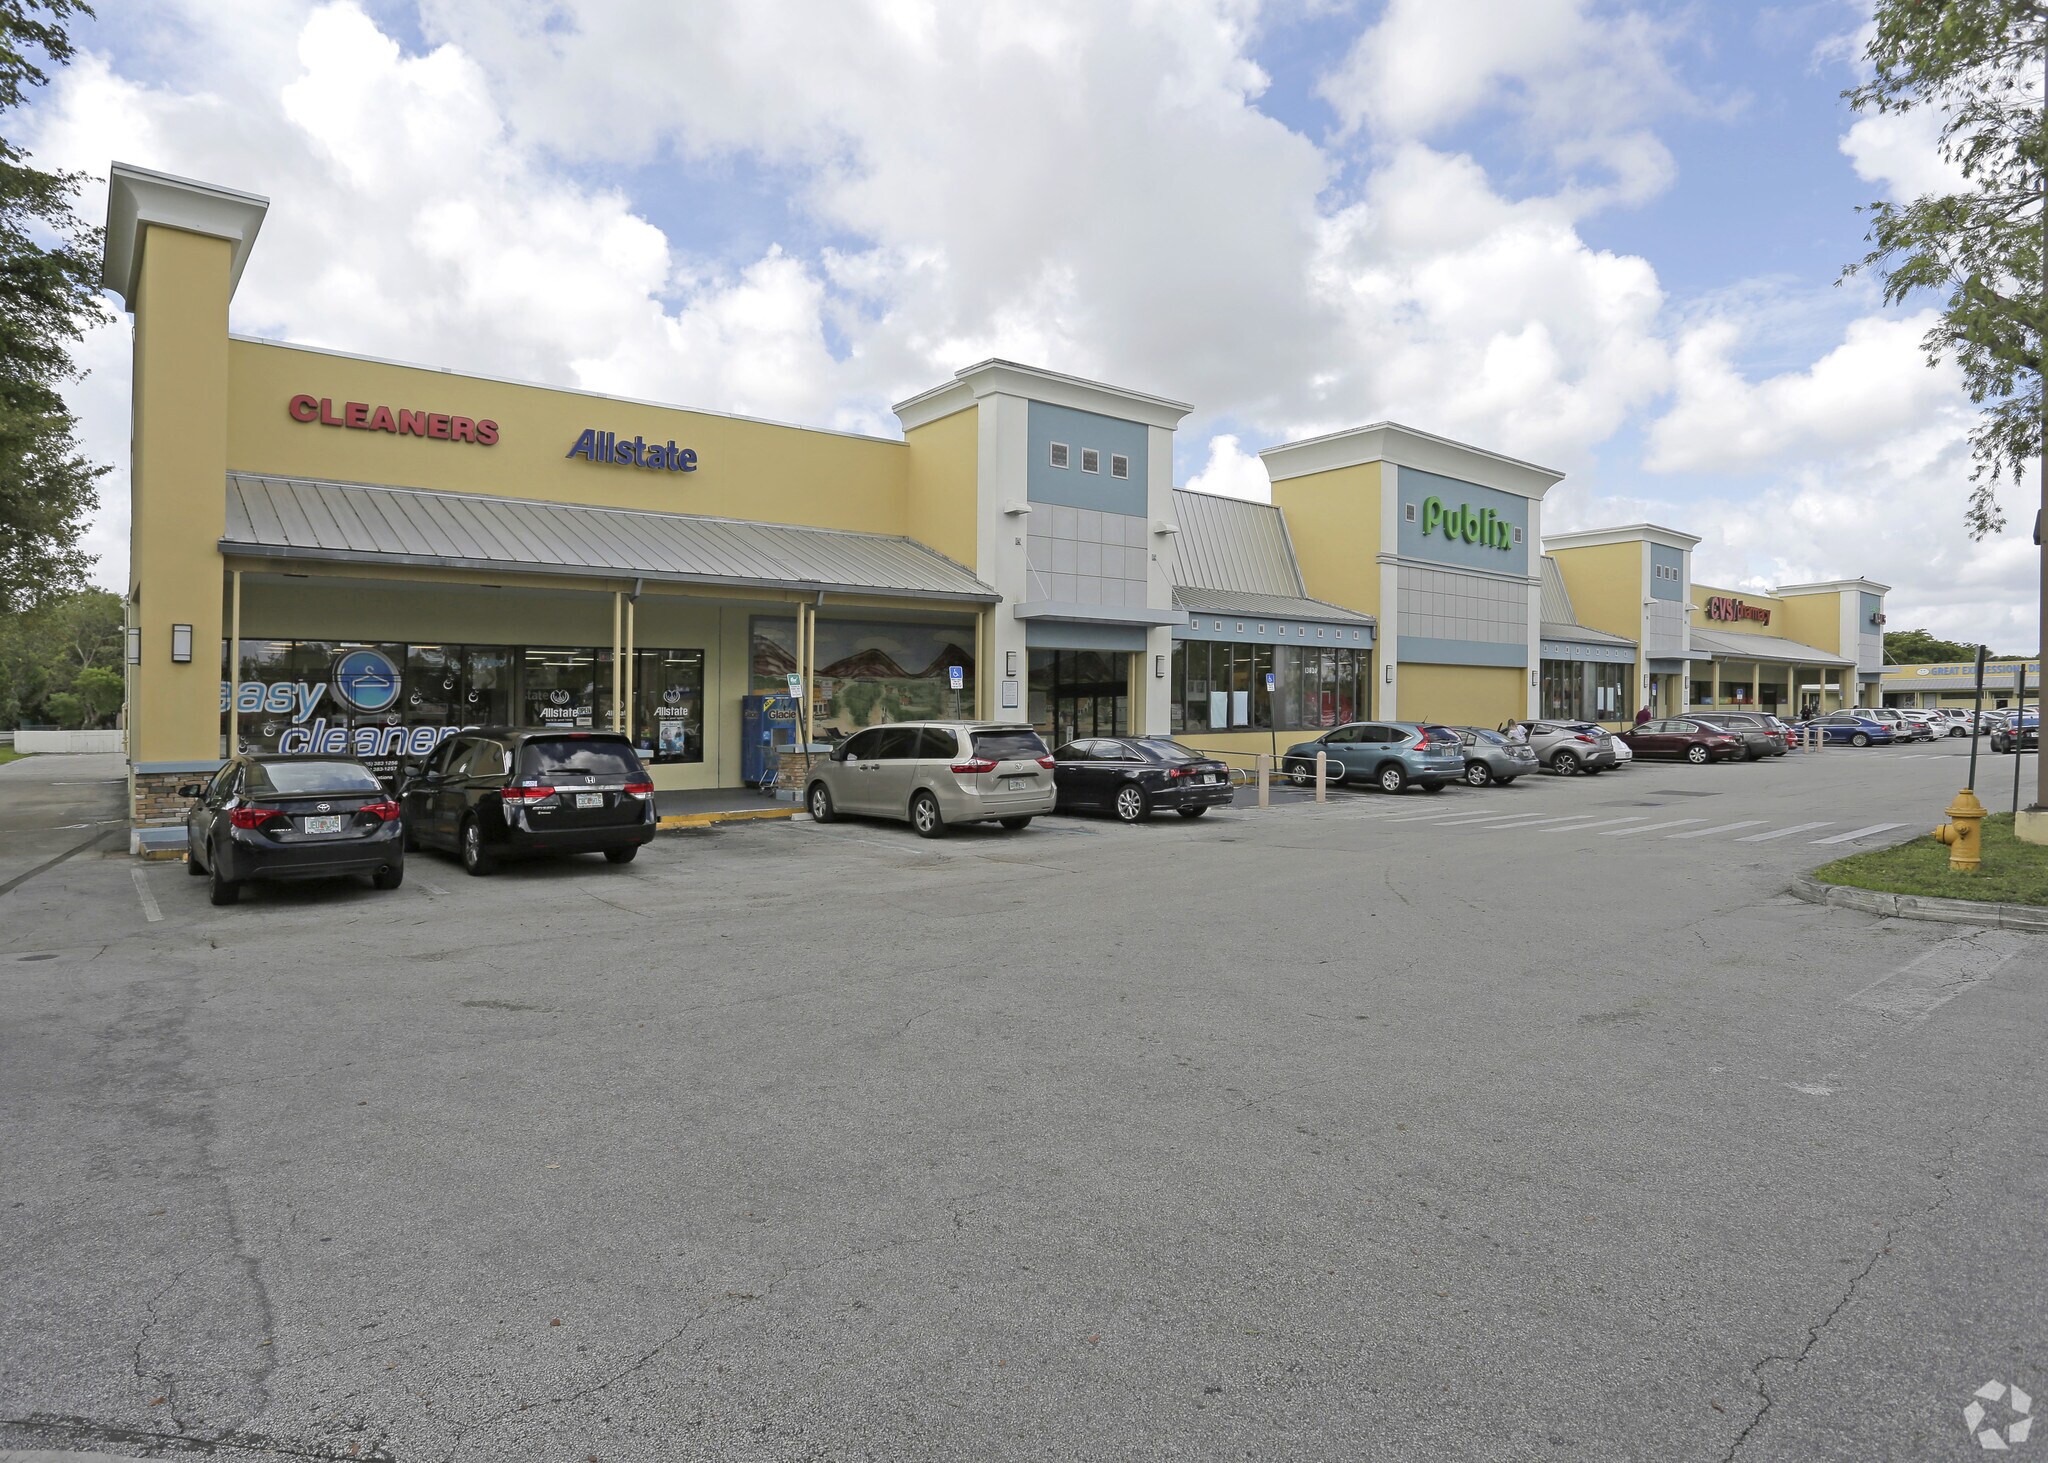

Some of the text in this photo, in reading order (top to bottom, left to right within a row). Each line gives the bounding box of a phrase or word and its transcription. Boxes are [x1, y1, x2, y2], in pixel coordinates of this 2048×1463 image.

[289, 394, 499, 446] CLEANERS
[565, 428, 698, 472] Allstate
[1423, 495, 1512, 551] Publix
[1931, 666, 1960, 675] GREAT
[1962, 664, 2021, 675] EXESSION
[539, 707, 578, 718] Allstate
[653, 706, 688, 716] Allstate
[768, 709, 797, 719] Glacie
[278, 718, 480, 756] cleaner
